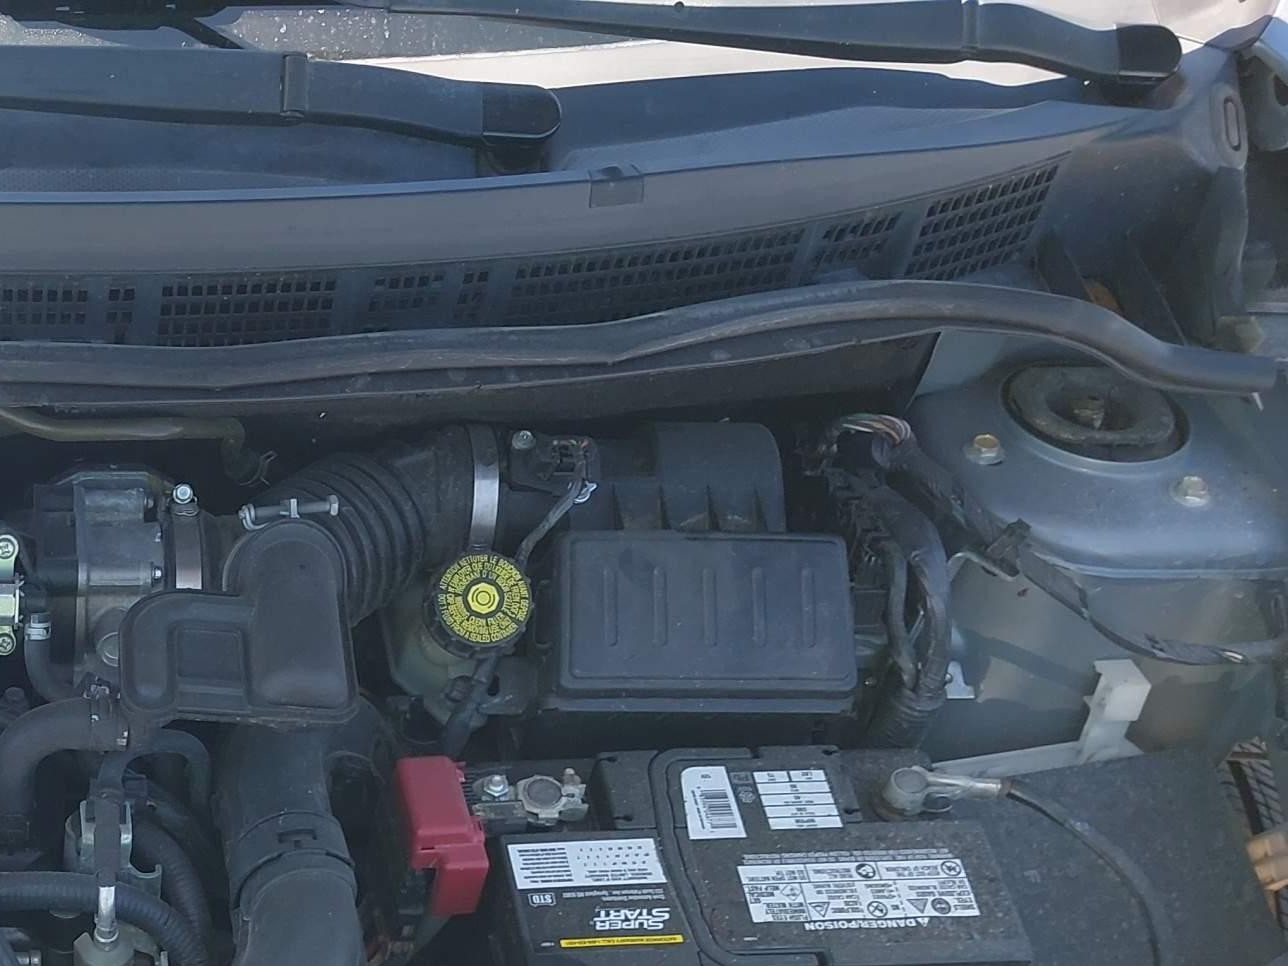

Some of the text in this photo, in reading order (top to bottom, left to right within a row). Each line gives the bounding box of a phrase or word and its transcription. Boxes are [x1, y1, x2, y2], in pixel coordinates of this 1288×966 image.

[533, 894, 553, 905] STD
[593, 908, 671, 921] START
[596, 920, 664, 930] SUPER
[804, 918, 917, 930] DANGER/POISON
